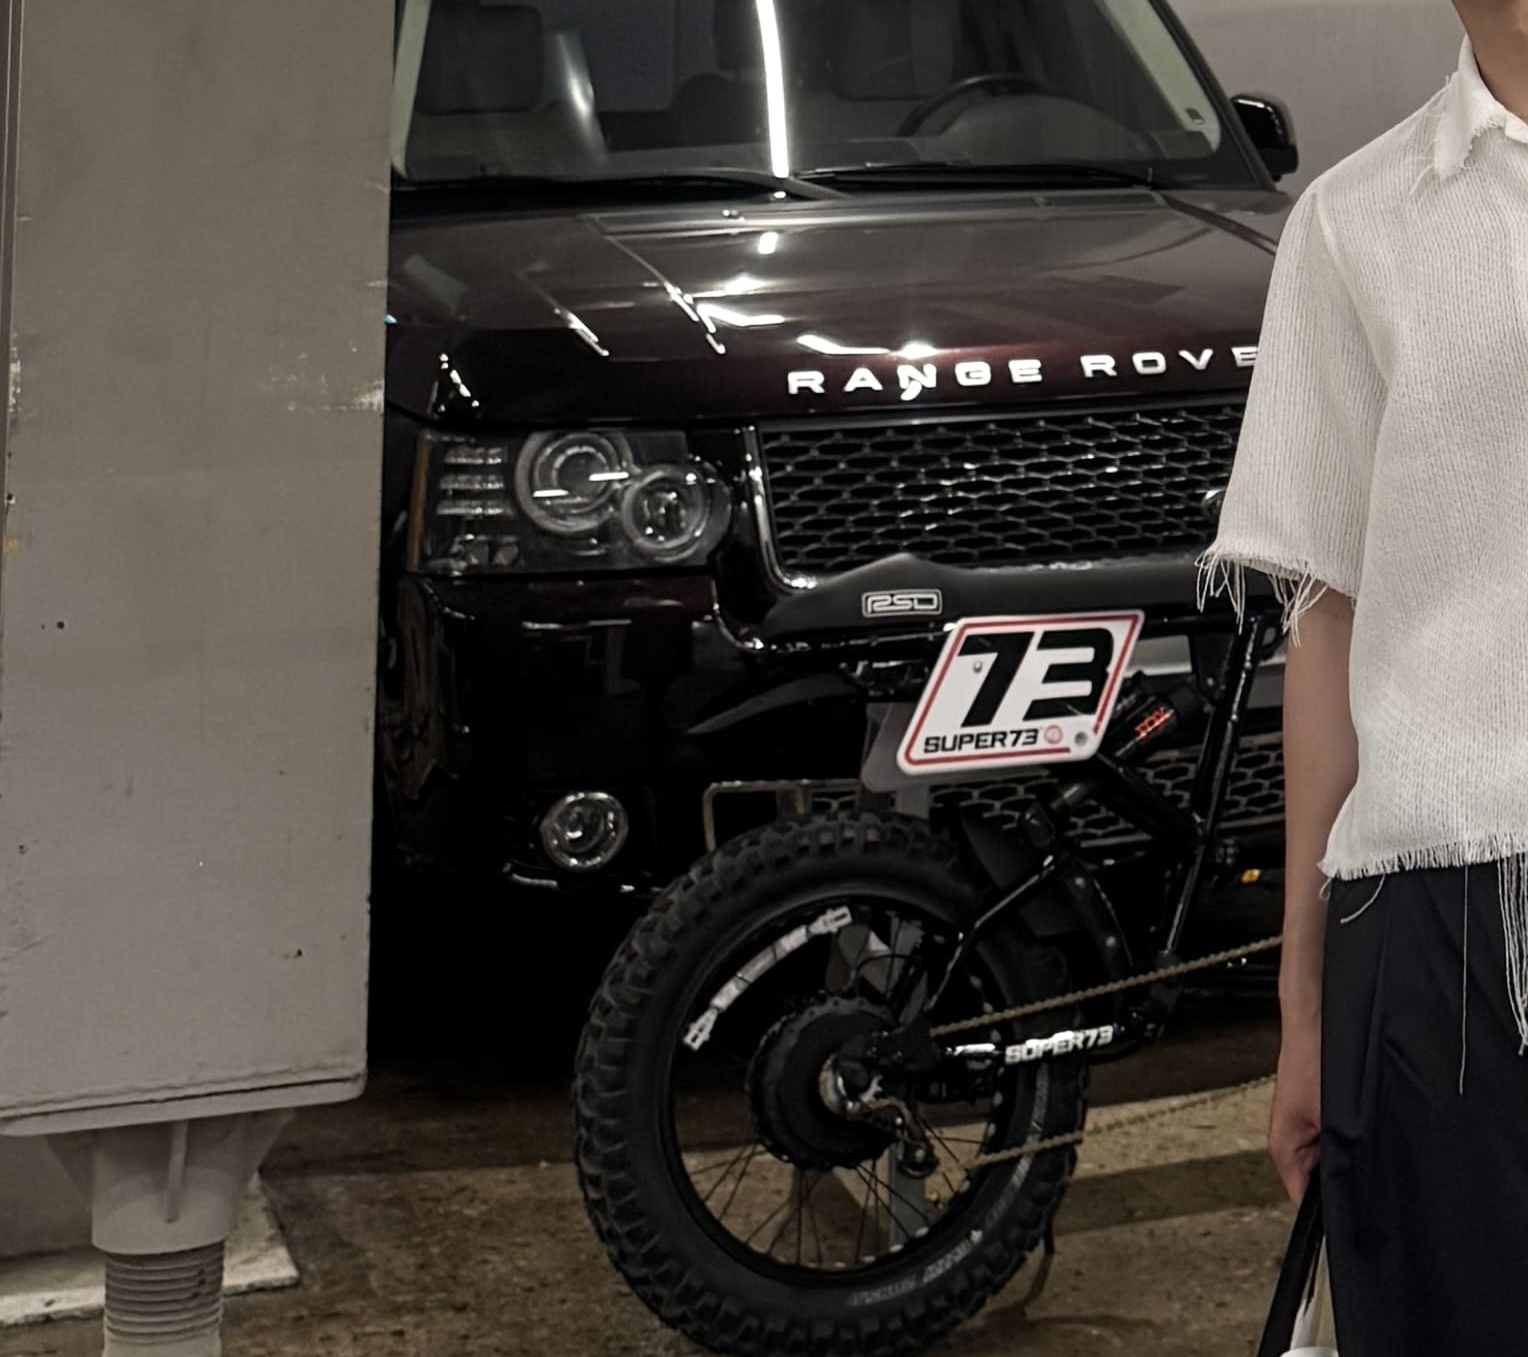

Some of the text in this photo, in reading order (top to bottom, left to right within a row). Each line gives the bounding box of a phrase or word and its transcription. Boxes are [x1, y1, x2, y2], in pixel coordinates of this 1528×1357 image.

[788, 345, 1259, 395] RANGE ROVE
[957, 627, 1114, 728] 73
[923, 728, 1039, 754] SUPER73
[1004, 1024, 1114, 1065] SUPER73
